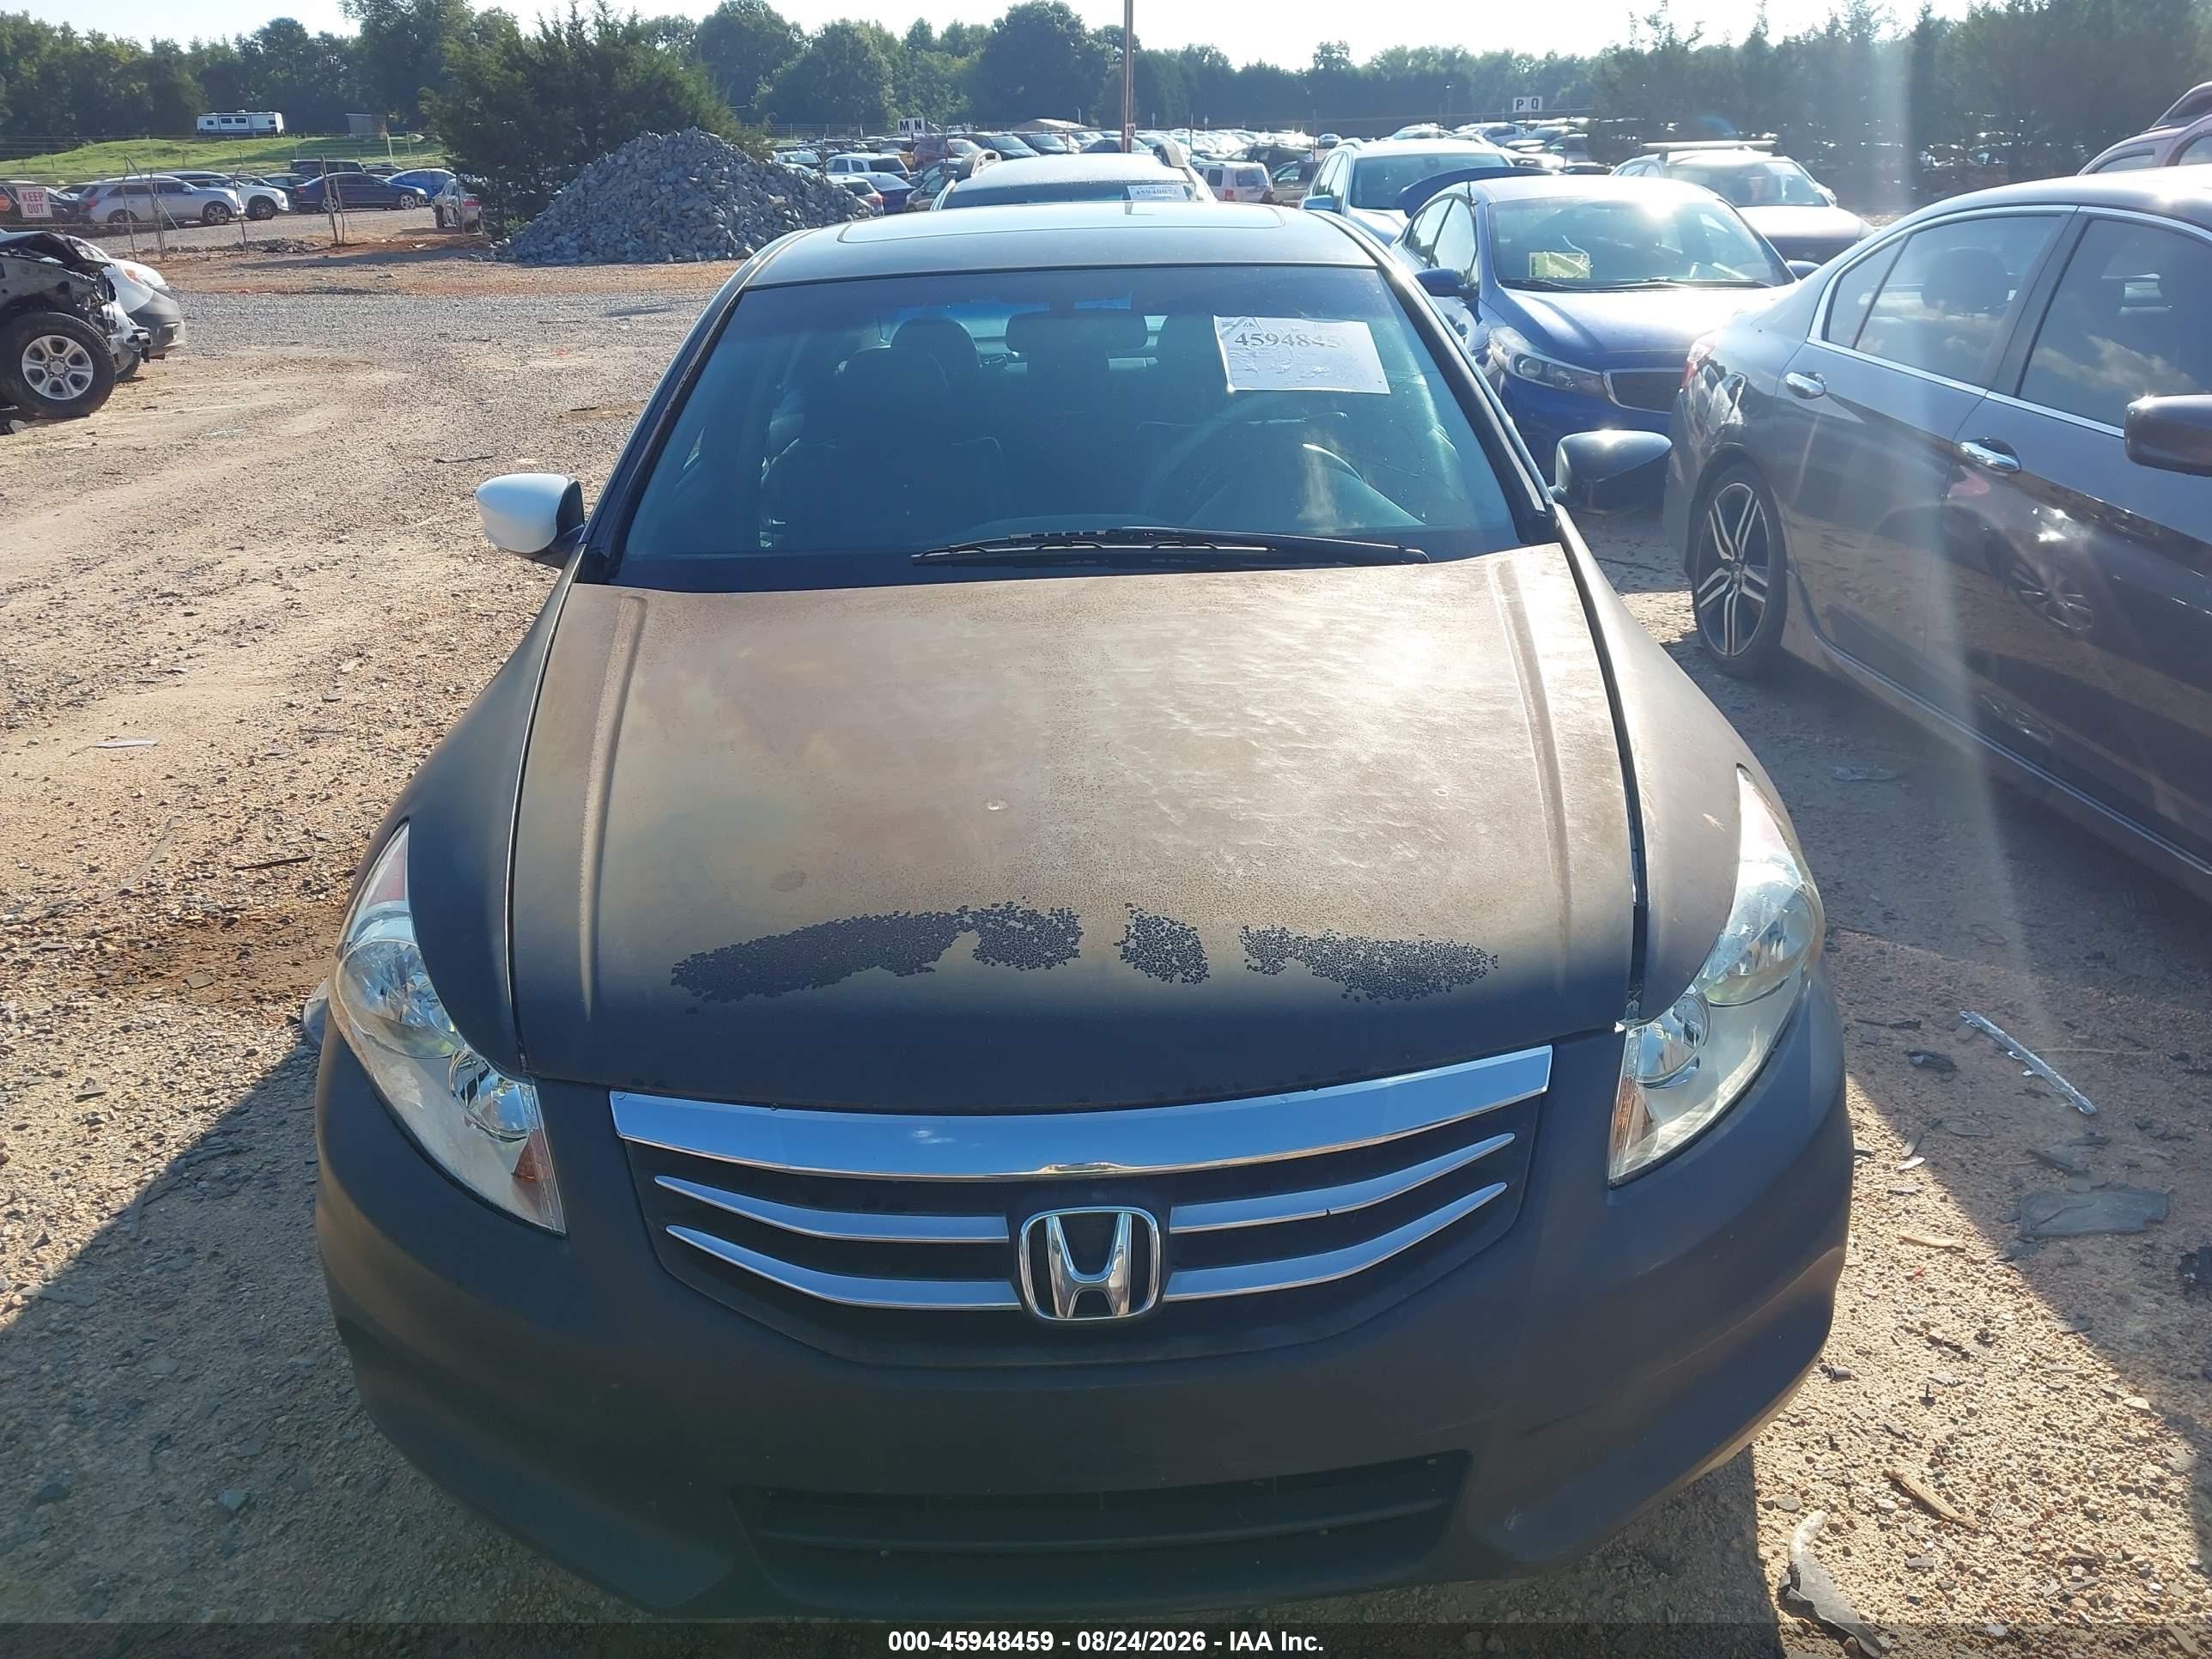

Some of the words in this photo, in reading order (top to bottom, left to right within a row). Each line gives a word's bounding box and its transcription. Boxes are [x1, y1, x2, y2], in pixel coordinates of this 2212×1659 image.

[1516, 99, 1524, 111] P
[1531, 98, 1539, 111] Q
[899, 120, 909, 131] M
[914, 118, 921, 131] N
[1127, 125, 1135, 137] 10
[21, 191, 44, 202] KEEP
[27, 203, 45, 214] OUT
[1235, 331, 1352, 349] 4594845
